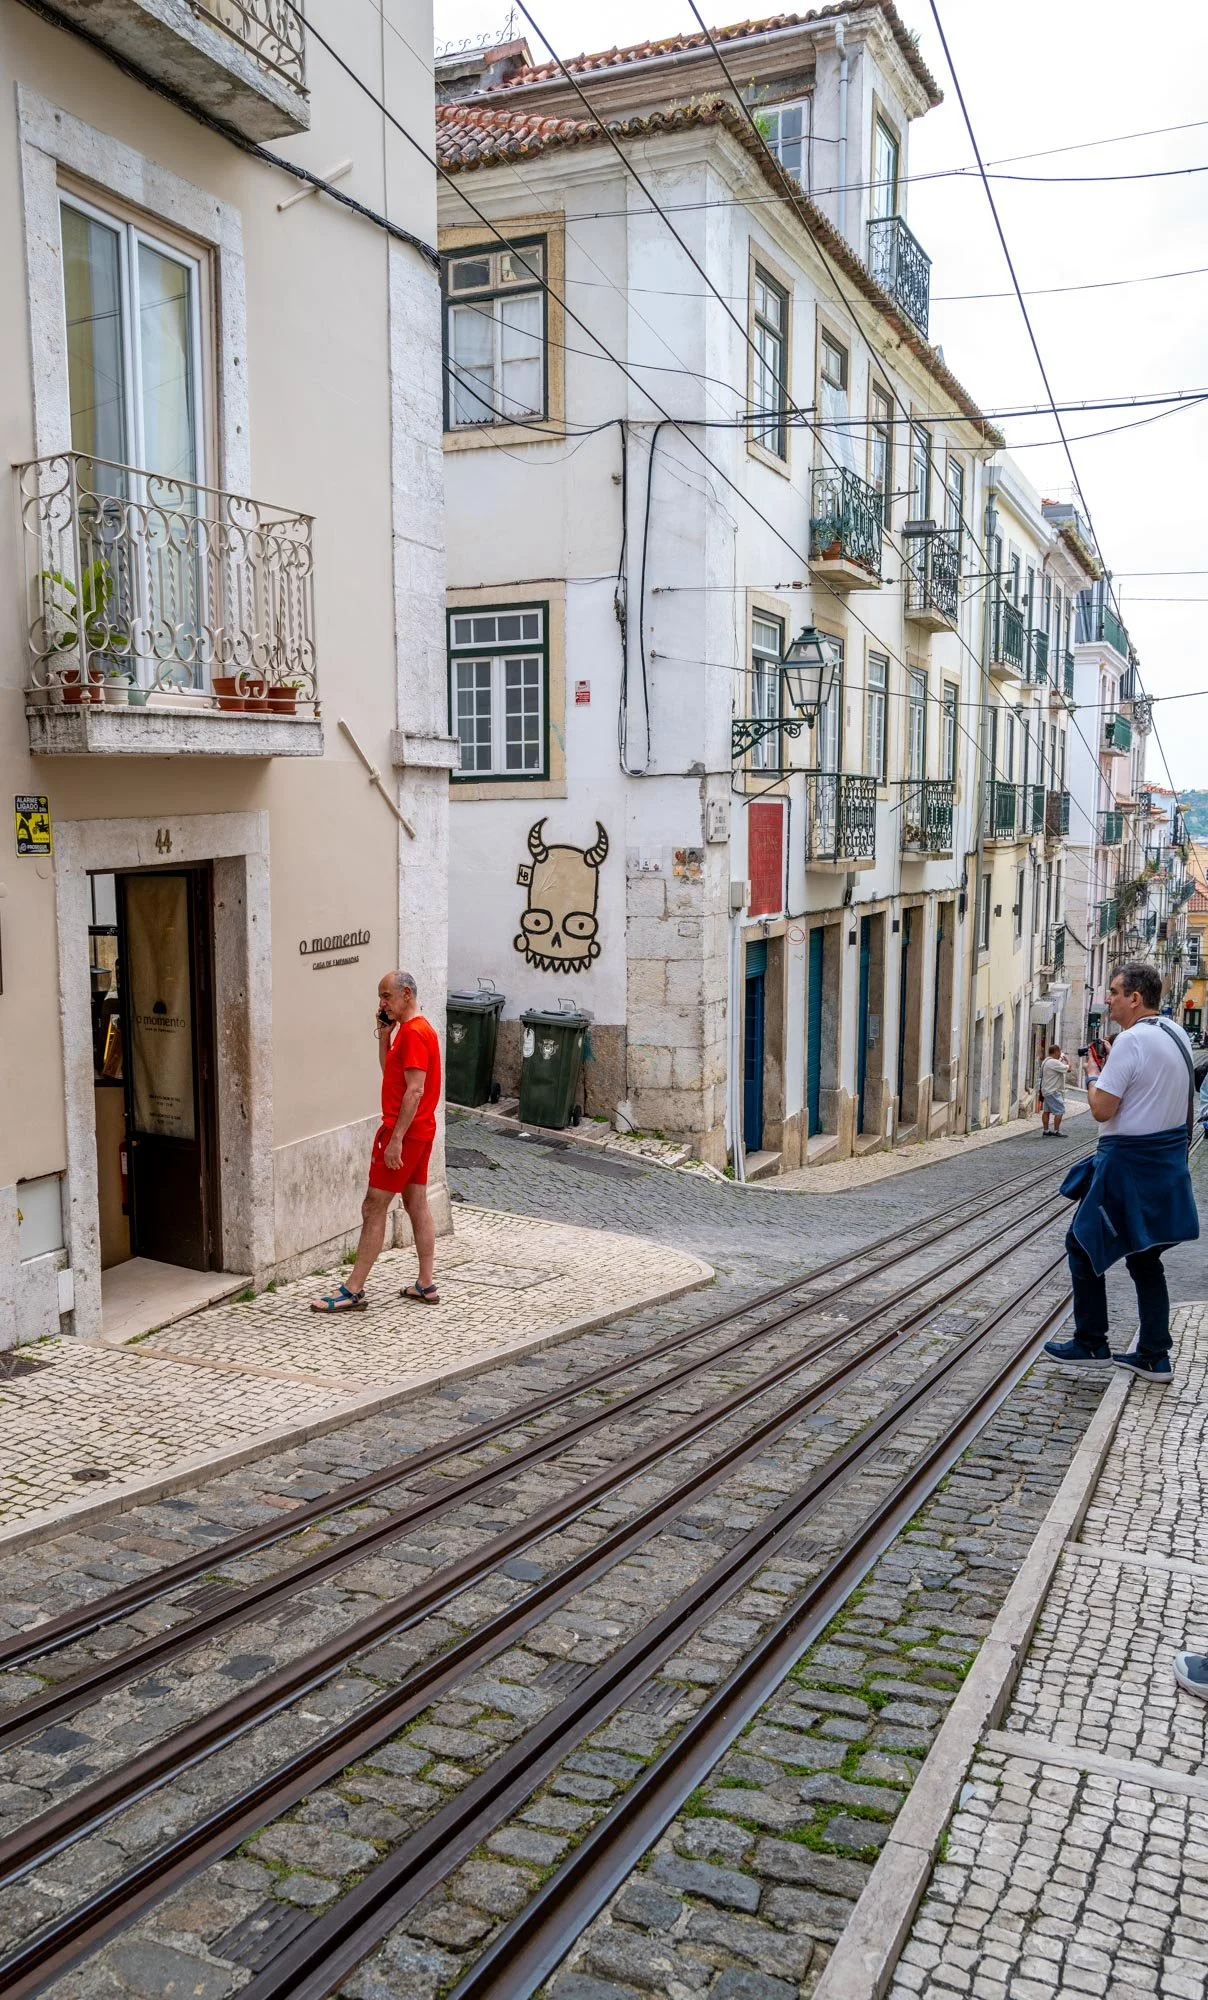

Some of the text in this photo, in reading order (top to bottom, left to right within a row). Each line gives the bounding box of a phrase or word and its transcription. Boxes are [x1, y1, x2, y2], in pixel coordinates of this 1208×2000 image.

[155, 828, 172, 854] 44
[312, 929, 370, 952] momento
[313, 961, 325, 970] CASA
[326, 960, 332, 968] DE
[143, 1016, 186, 1028] momento
